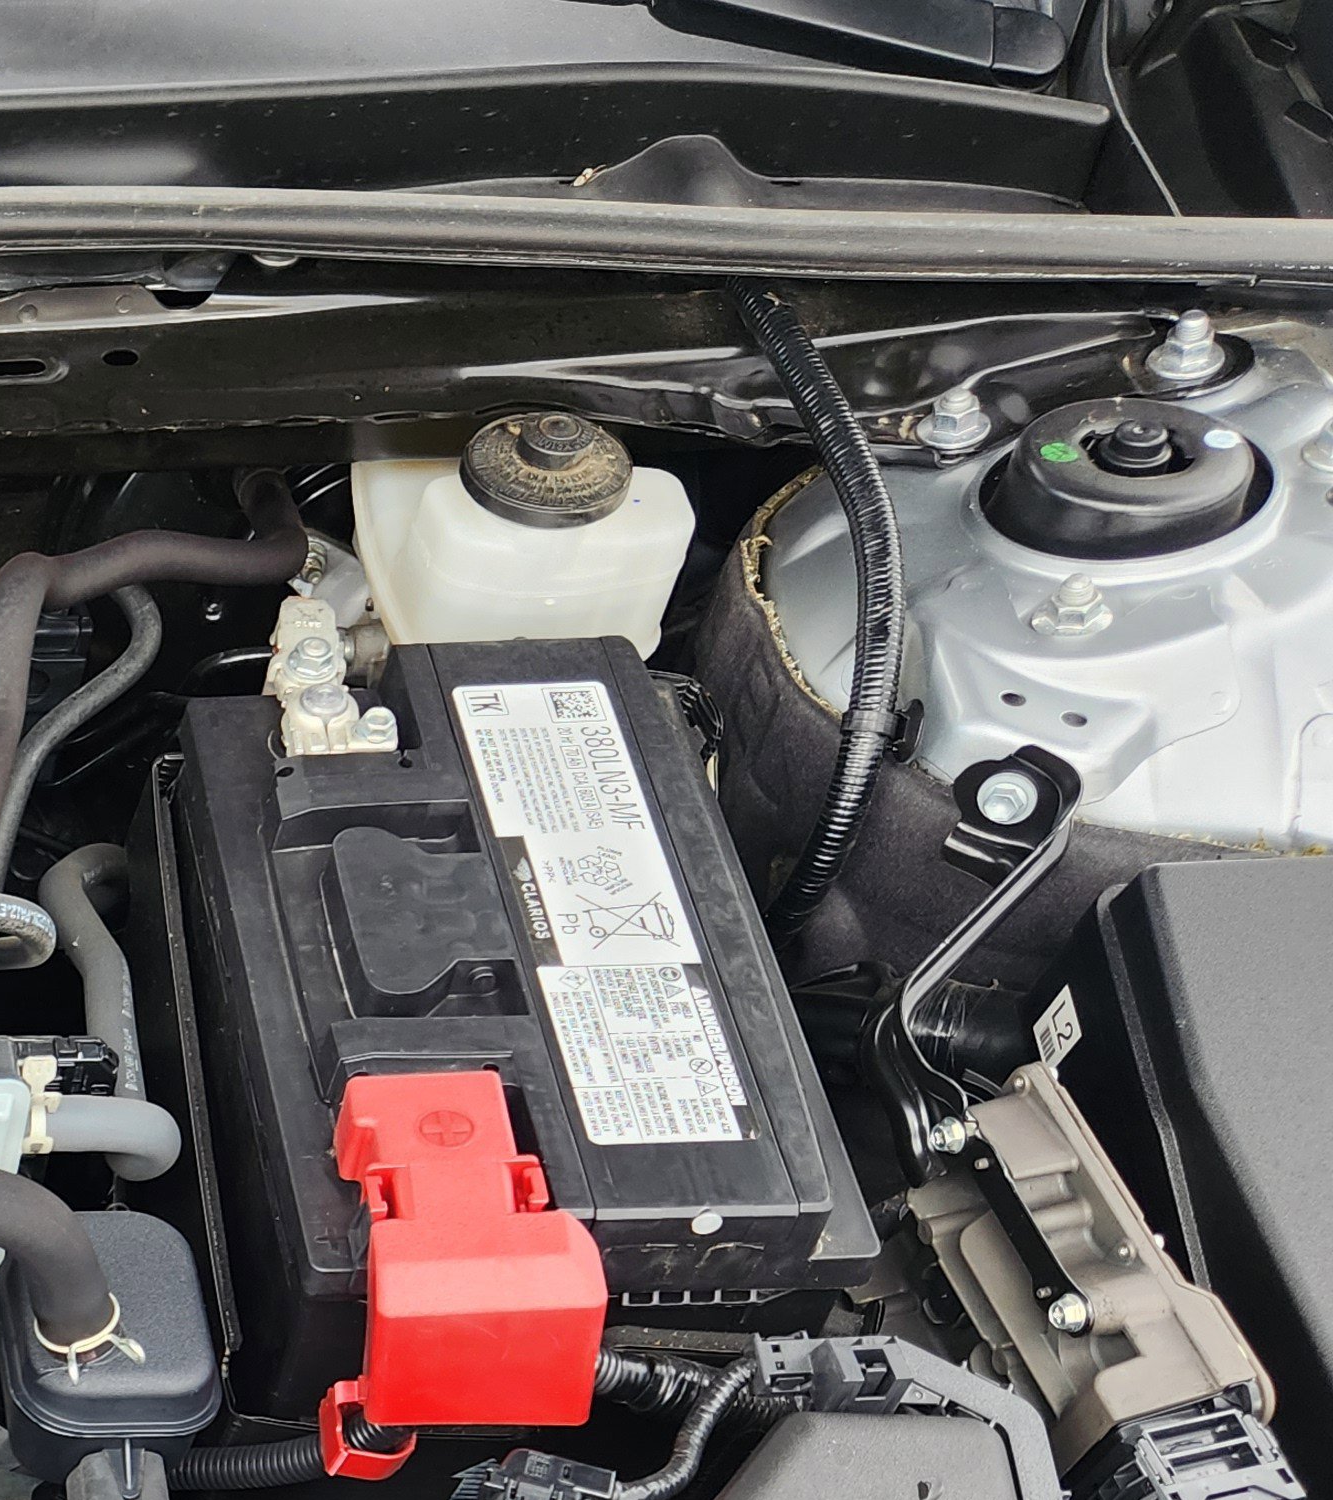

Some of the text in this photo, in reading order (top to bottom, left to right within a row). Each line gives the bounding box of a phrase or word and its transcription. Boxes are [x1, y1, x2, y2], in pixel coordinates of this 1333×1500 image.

[466, 692, 503, 712] TK
[581, 726, 645, 830] 380LN3-MF
[520, 882, 552, 940] CLARIOS
[555, 913, 583, 934] Pb
[696, 996, 748, 1106] DANGER/POISON
[1051, 1000, 1073, 1051] L2
